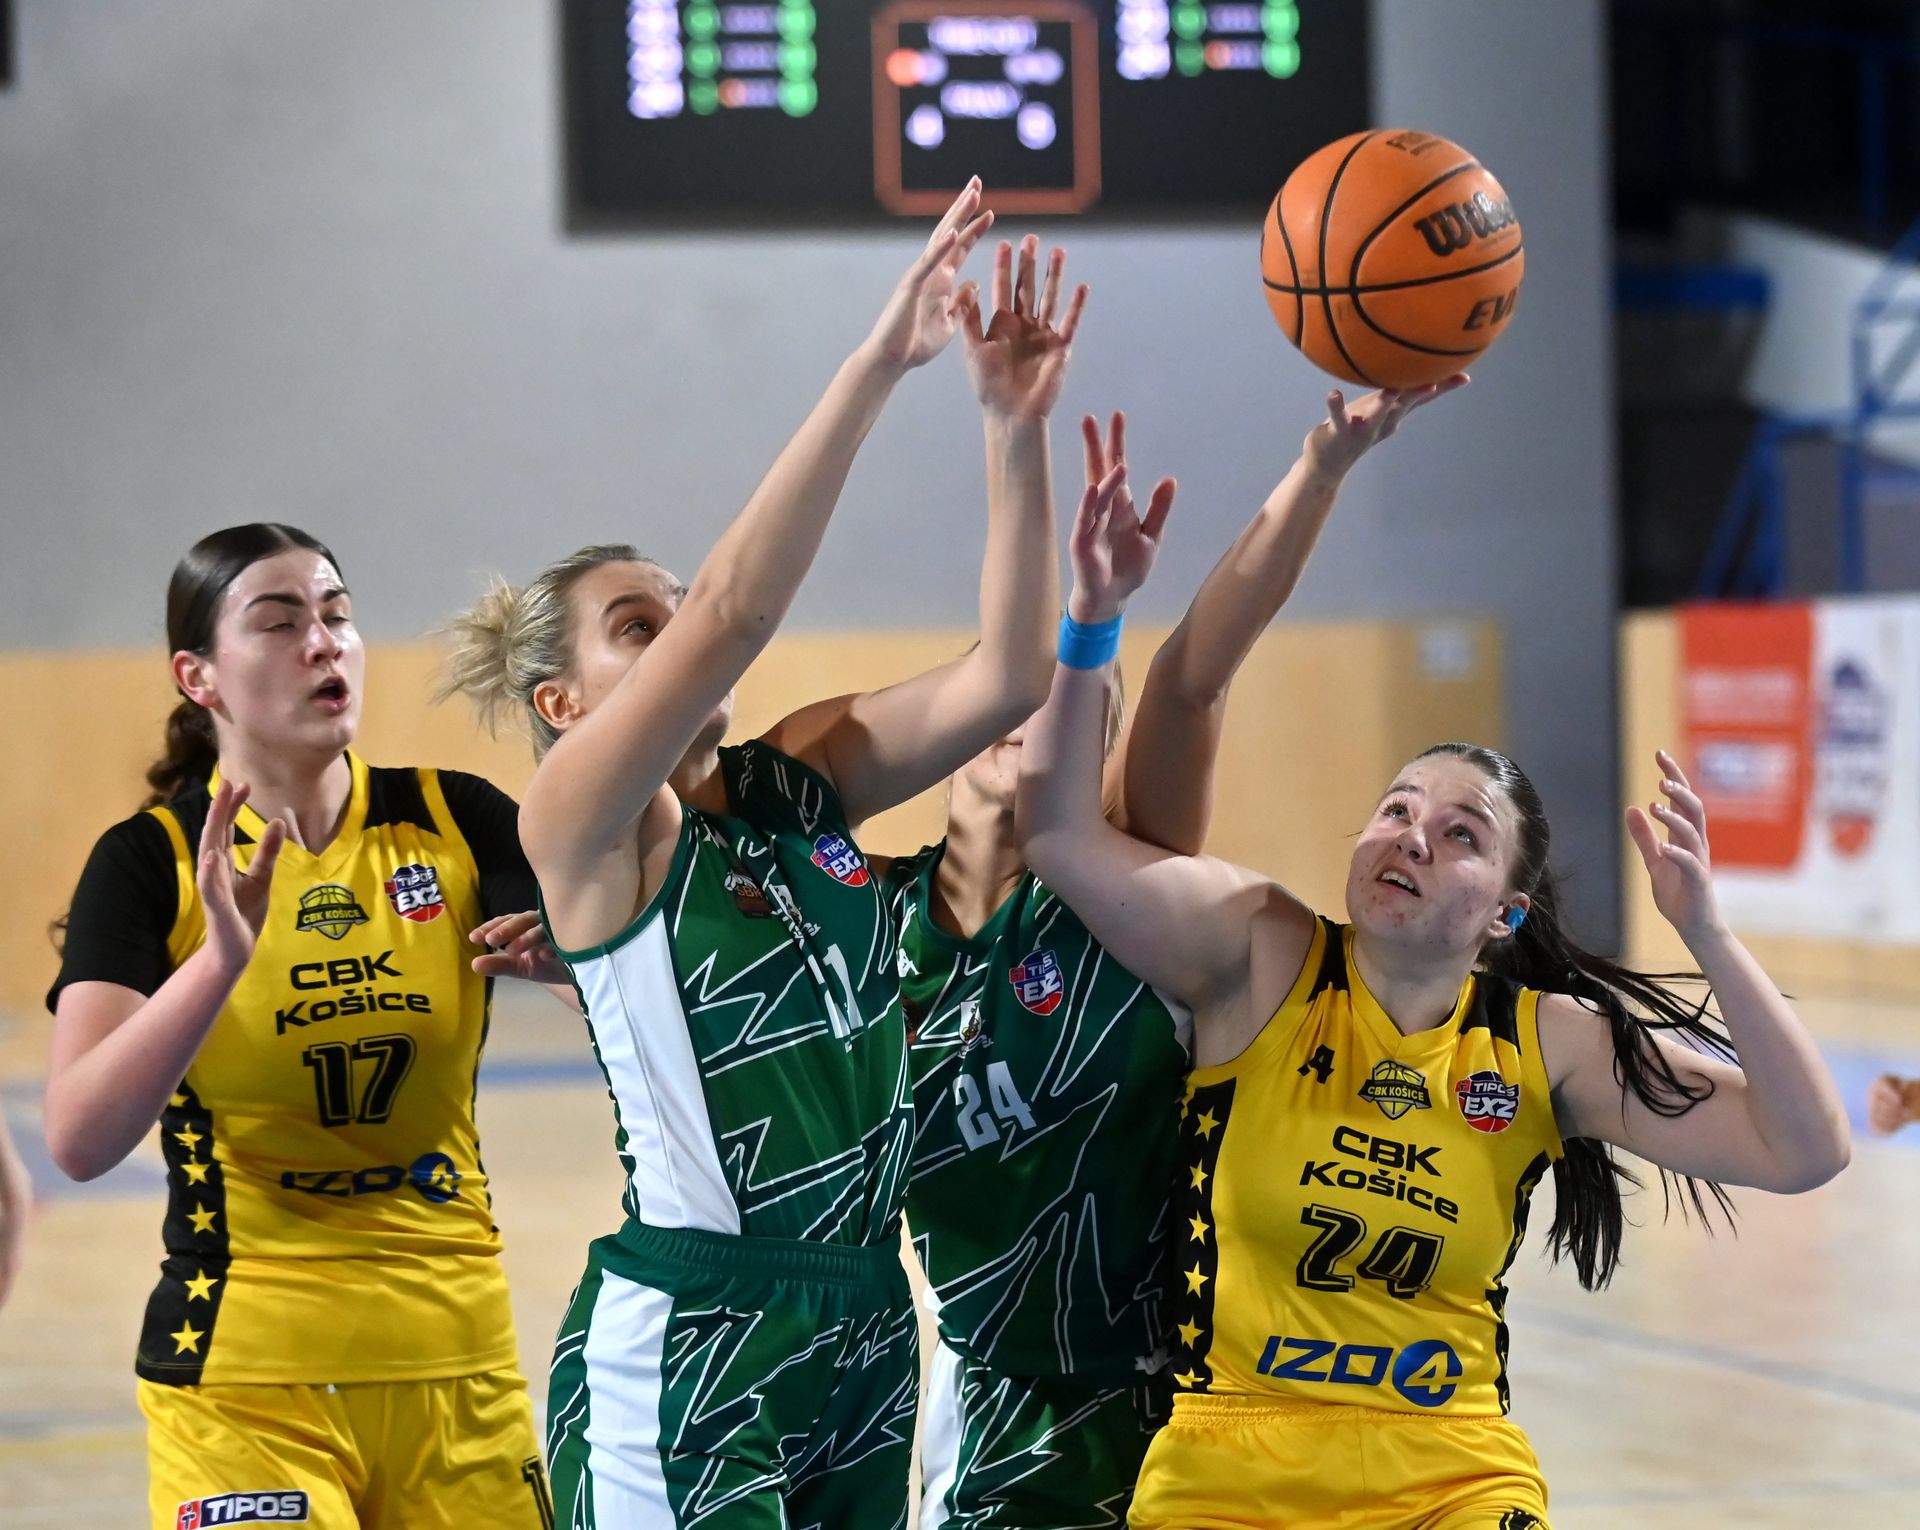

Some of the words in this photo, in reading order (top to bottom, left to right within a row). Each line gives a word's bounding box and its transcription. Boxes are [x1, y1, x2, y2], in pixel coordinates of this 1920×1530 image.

[396, 883, 443, 913] EXZ
[289, 950, 404, 992] CBK
[274, 987, 433, 1037] Košice
[302, 1033, 418, 1128] 17
[1367, 1085, 1388, 1096] CBK
[1388, 1084, 1425, 1101] KOŠICE
[952, 1060, 1038, 1152] 24
[1464, 1096, 1517, 1119] EXZ
[1332, 1125, 1443, 1177] CBK
[1299, 1160, 1458, 1224] Košice
[1296, 1203, 1445, 1299] 24
[205, 1494, 303, 1522] TIPOS
